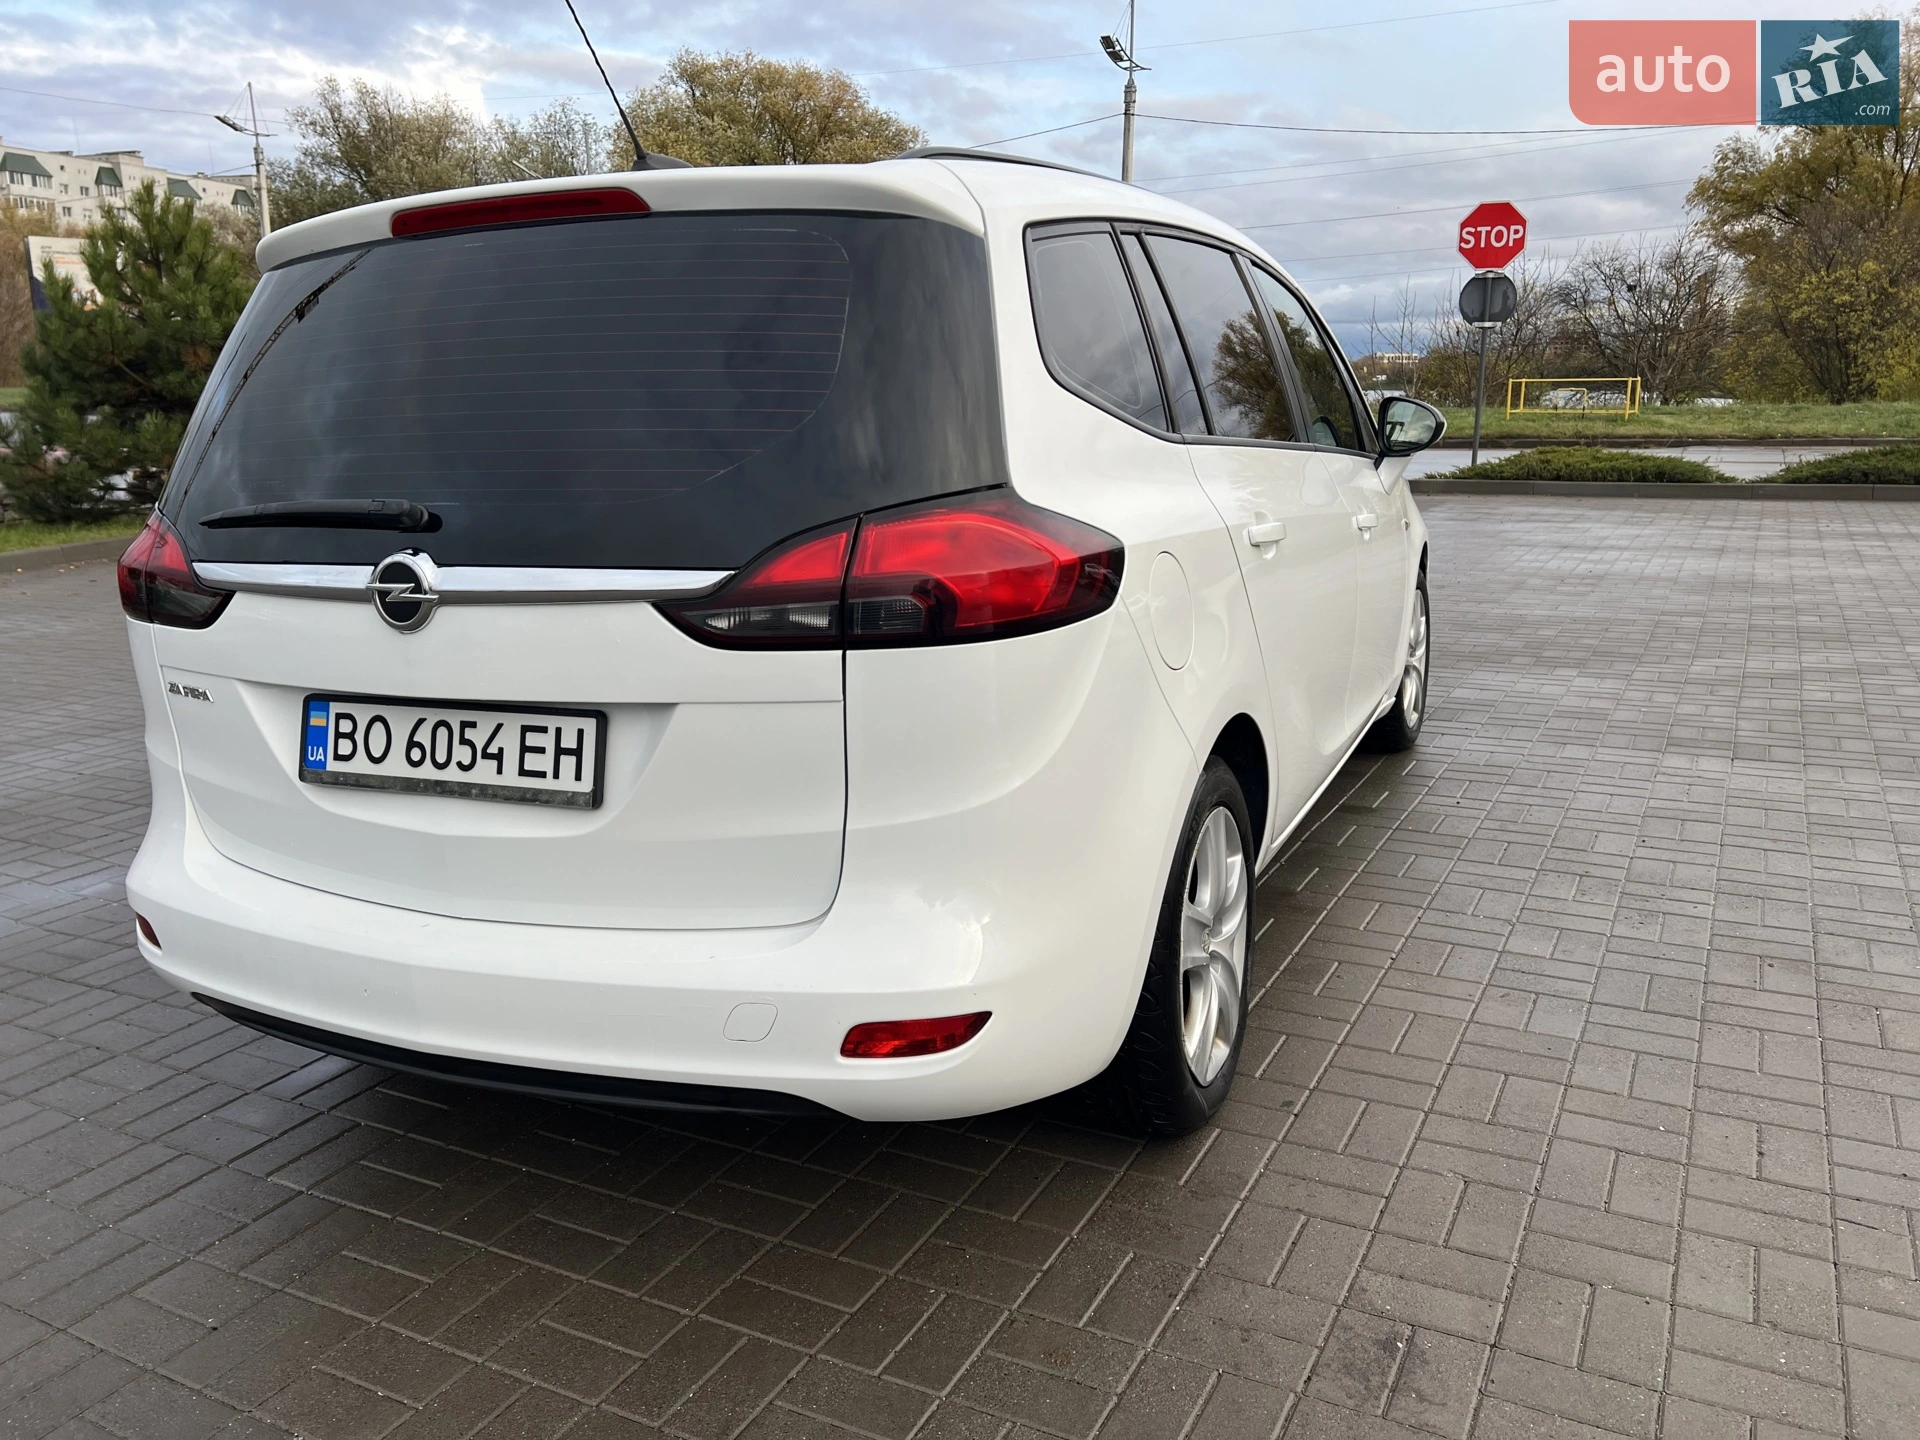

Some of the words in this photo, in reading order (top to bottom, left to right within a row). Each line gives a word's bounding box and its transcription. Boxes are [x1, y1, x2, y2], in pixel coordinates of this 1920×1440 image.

[1460, 225, 1524, 249] STOP
[308, 745, 325, 762] UA
[333, 712, 392, 765] BO
[405, 717, 504, 775] 6054
[518, 724, 584, 782] EH
